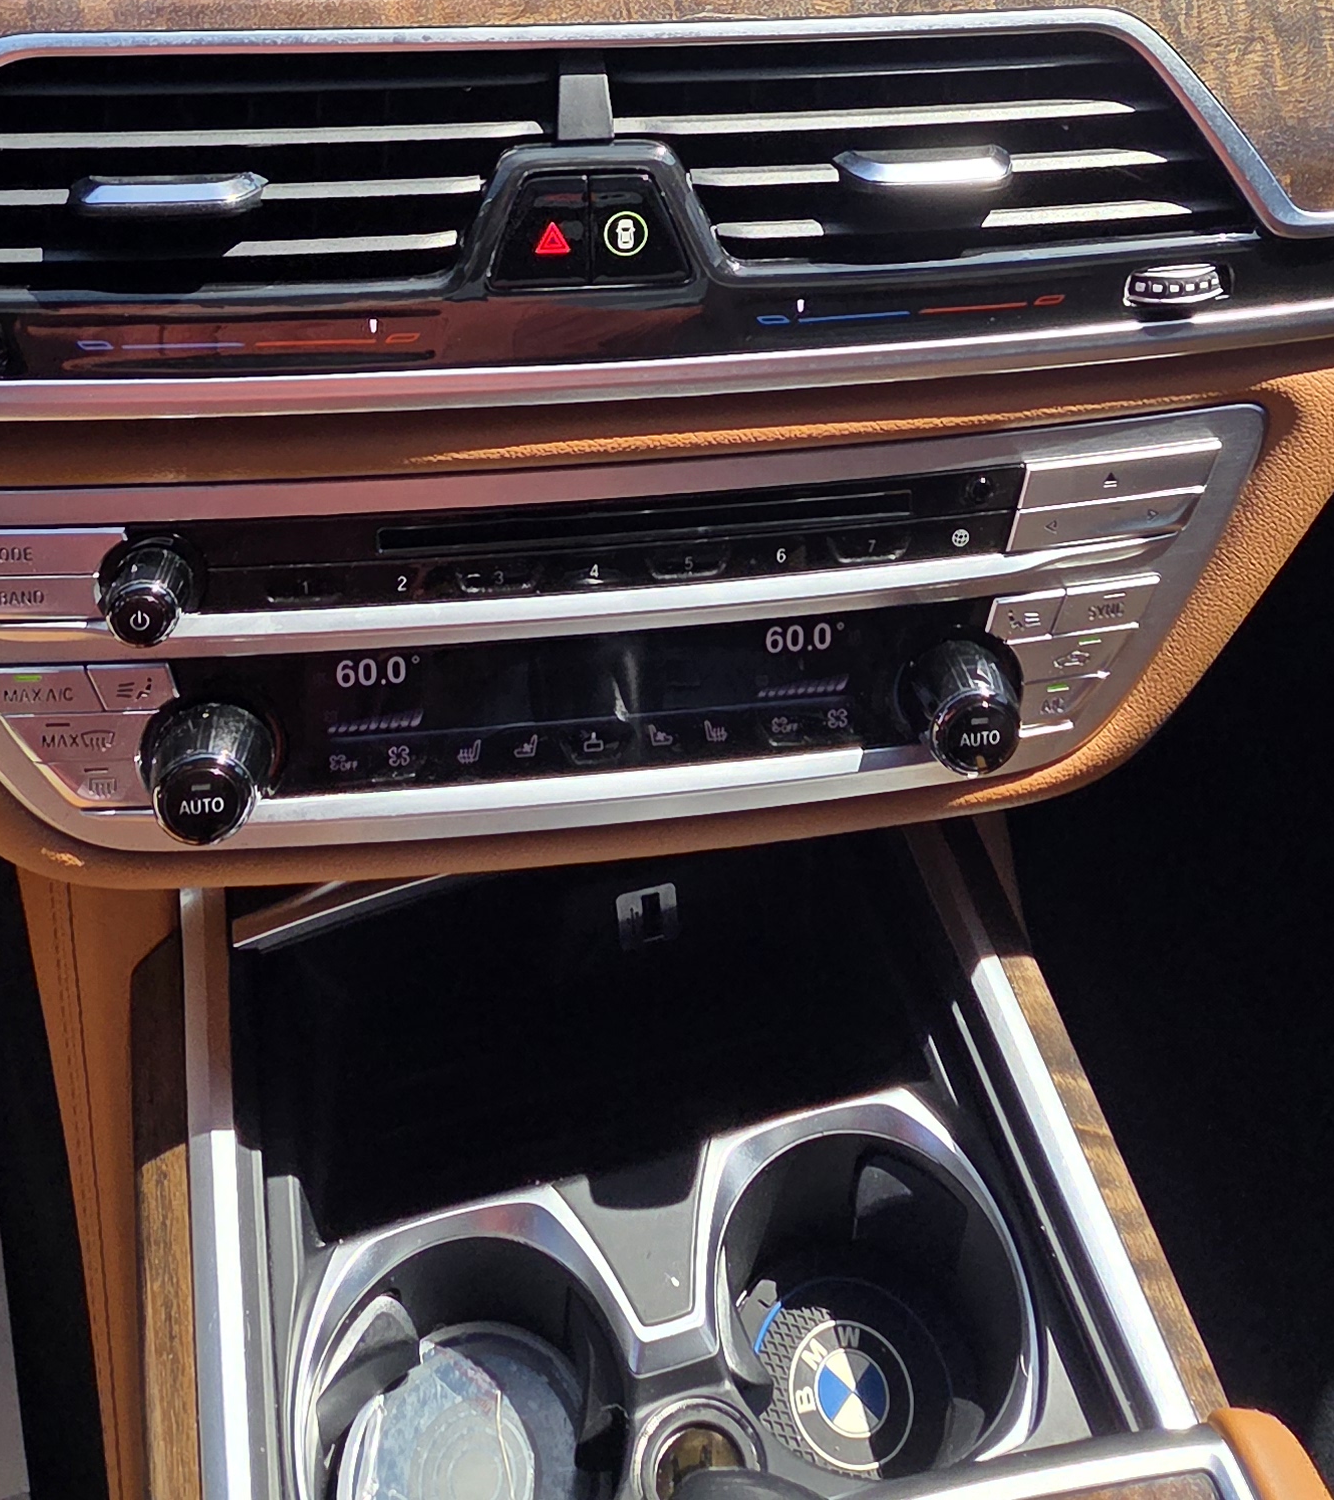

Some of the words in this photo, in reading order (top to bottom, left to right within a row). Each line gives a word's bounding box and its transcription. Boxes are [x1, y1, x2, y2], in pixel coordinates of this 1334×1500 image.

[775, 547, 787, 564] 6
[494, 570, 505, 586] 3
[589, 563, 600, 579] 4
[396, 575, 408, 593] 2
[1087, 603, 1126, 622] SYNC
[40, 734, 80, 750] MAX
[959, 729, 1001, 748] AUTO
[178, 796, 225, 816] AUTO
[795, 1325, 861, 1415] BMW
